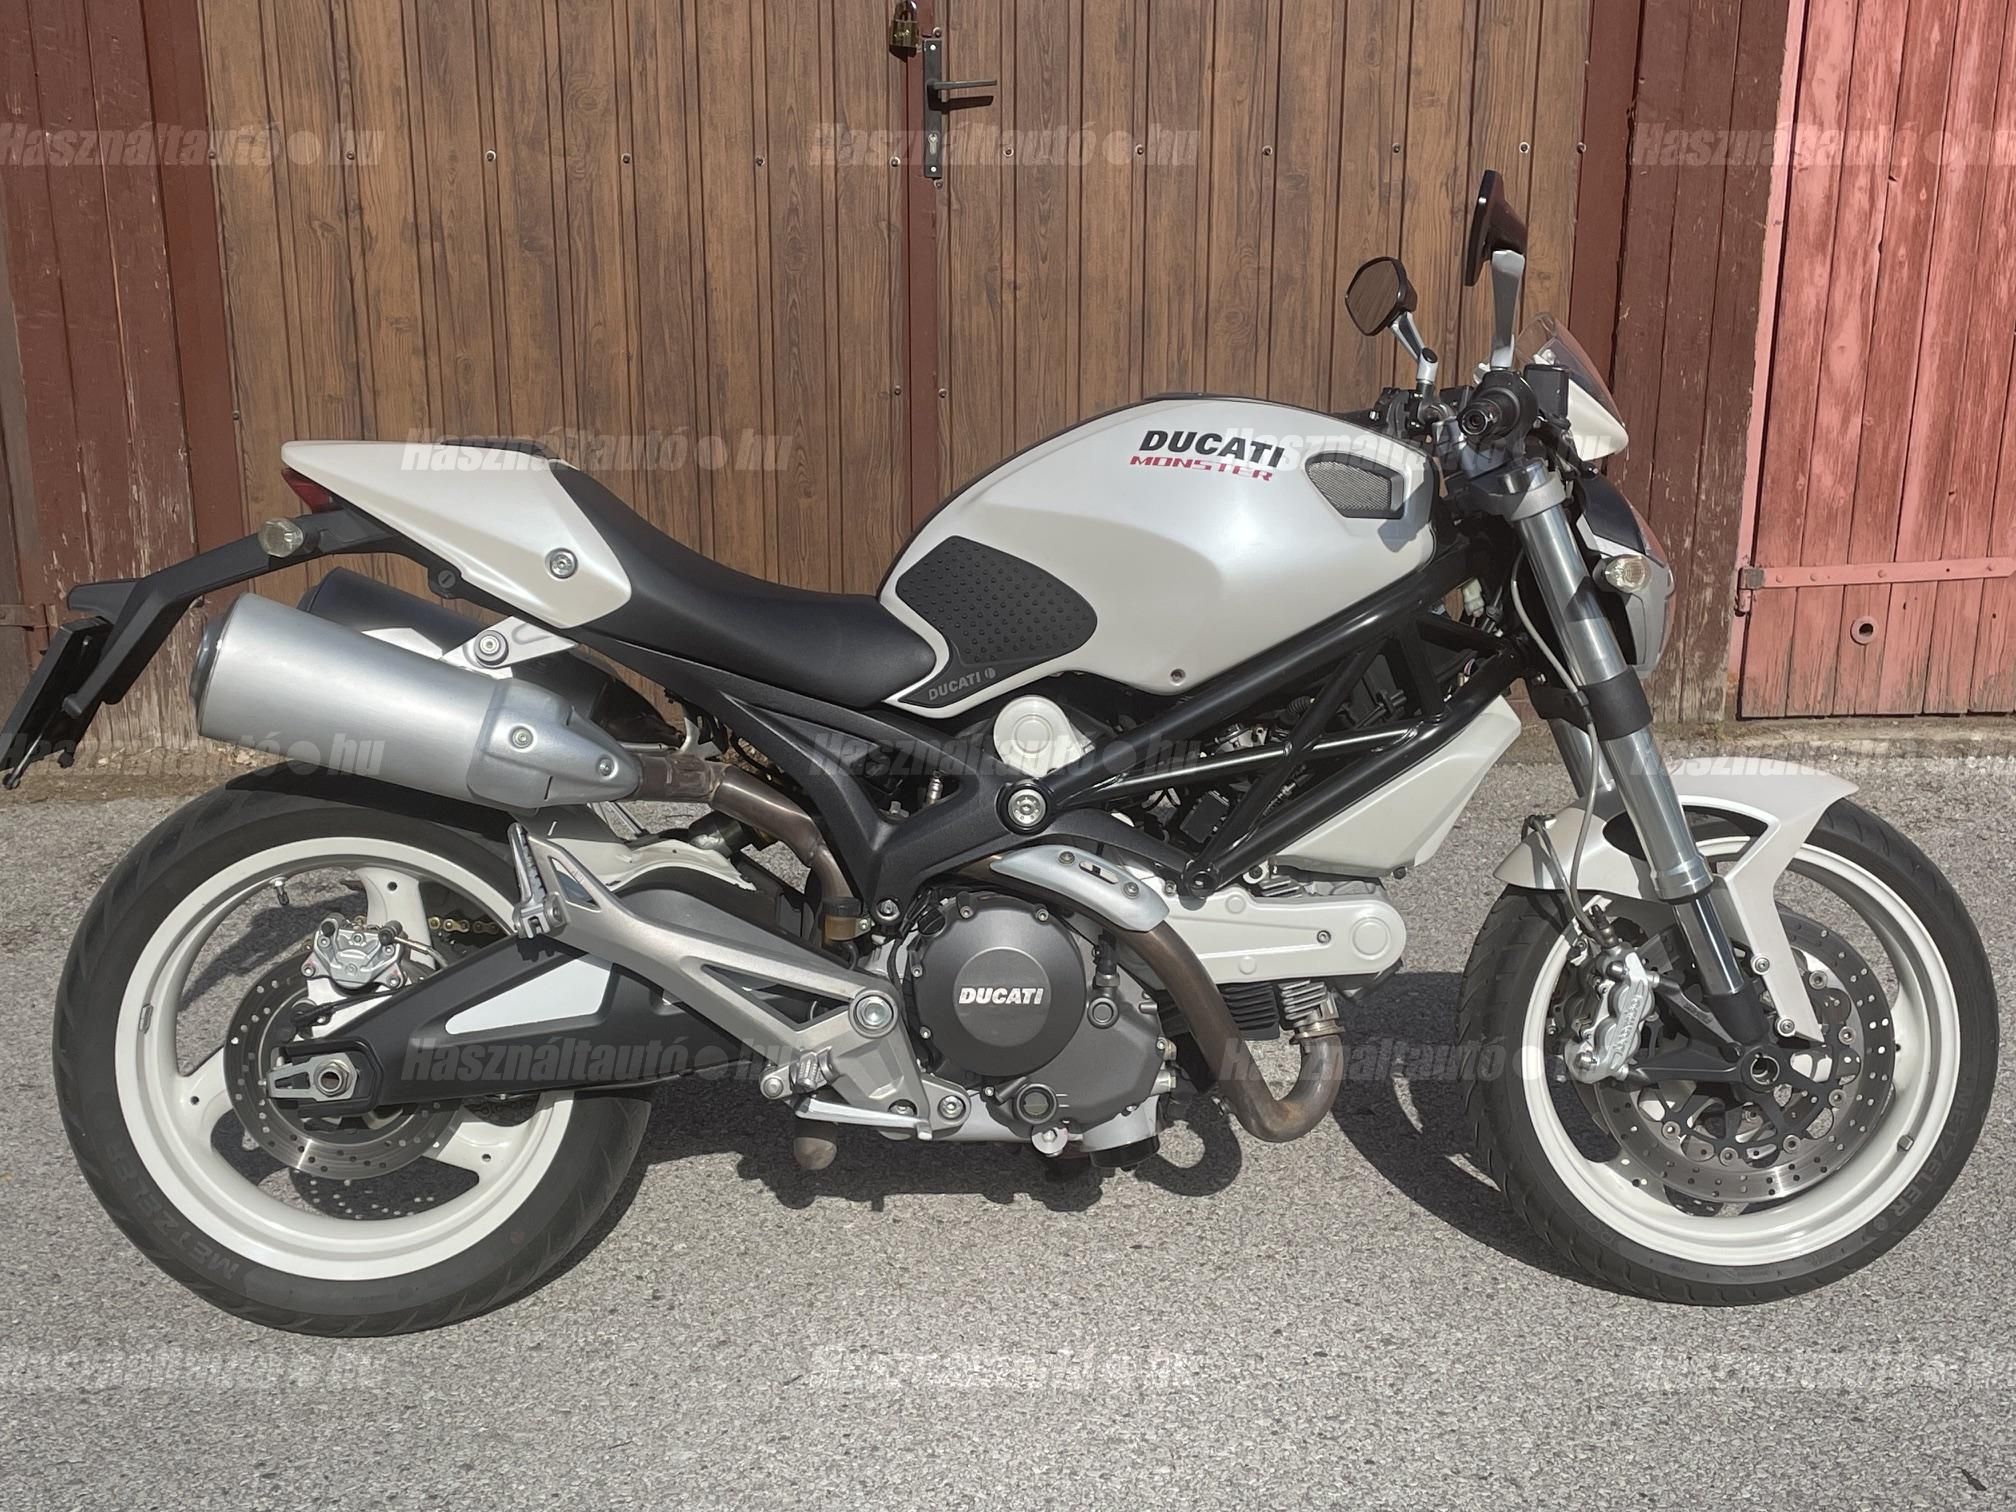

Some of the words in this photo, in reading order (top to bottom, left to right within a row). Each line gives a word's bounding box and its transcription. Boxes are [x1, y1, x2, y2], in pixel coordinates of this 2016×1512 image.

[1139, 430, 1285, 468] DUCATI
[1130, 455, 1273, 482] MONSTER
[928, 671, 981, 701] DUCATI
[958, 987, 1044, 1005] DUCATI
